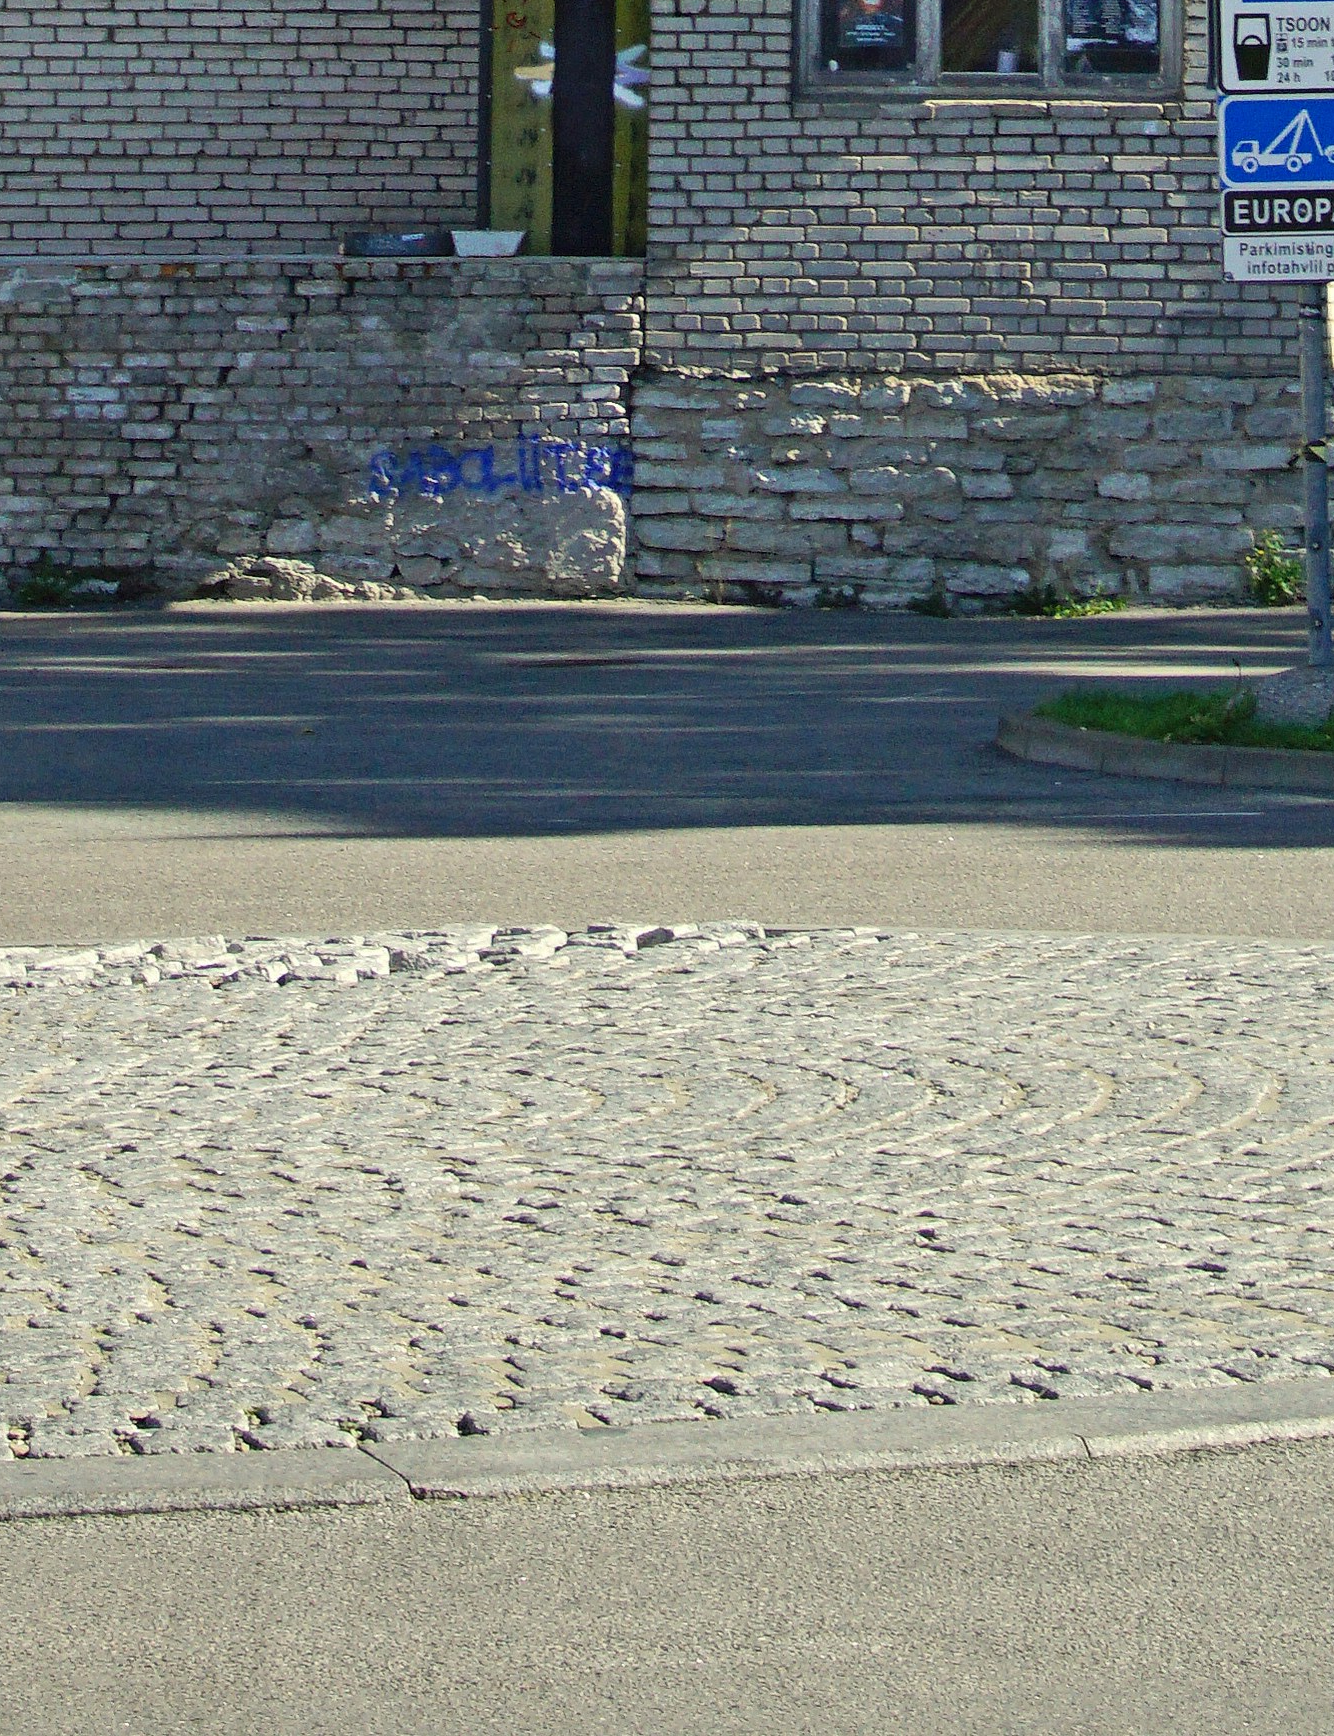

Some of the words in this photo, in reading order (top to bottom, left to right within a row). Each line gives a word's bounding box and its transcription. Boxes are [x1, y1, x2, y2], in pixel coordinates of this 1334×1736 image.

[1276, 16, 1330, 32] TSOON
[1291, 37, 1305, 48] 15
[1307, 36, 1328, 47] min
[1276, 57, 1289, 68] 30
[1292, 57, 1314, 67] min
[1276, 72, 1291, 84] 24
[1293, 72, 1301, 83] h
